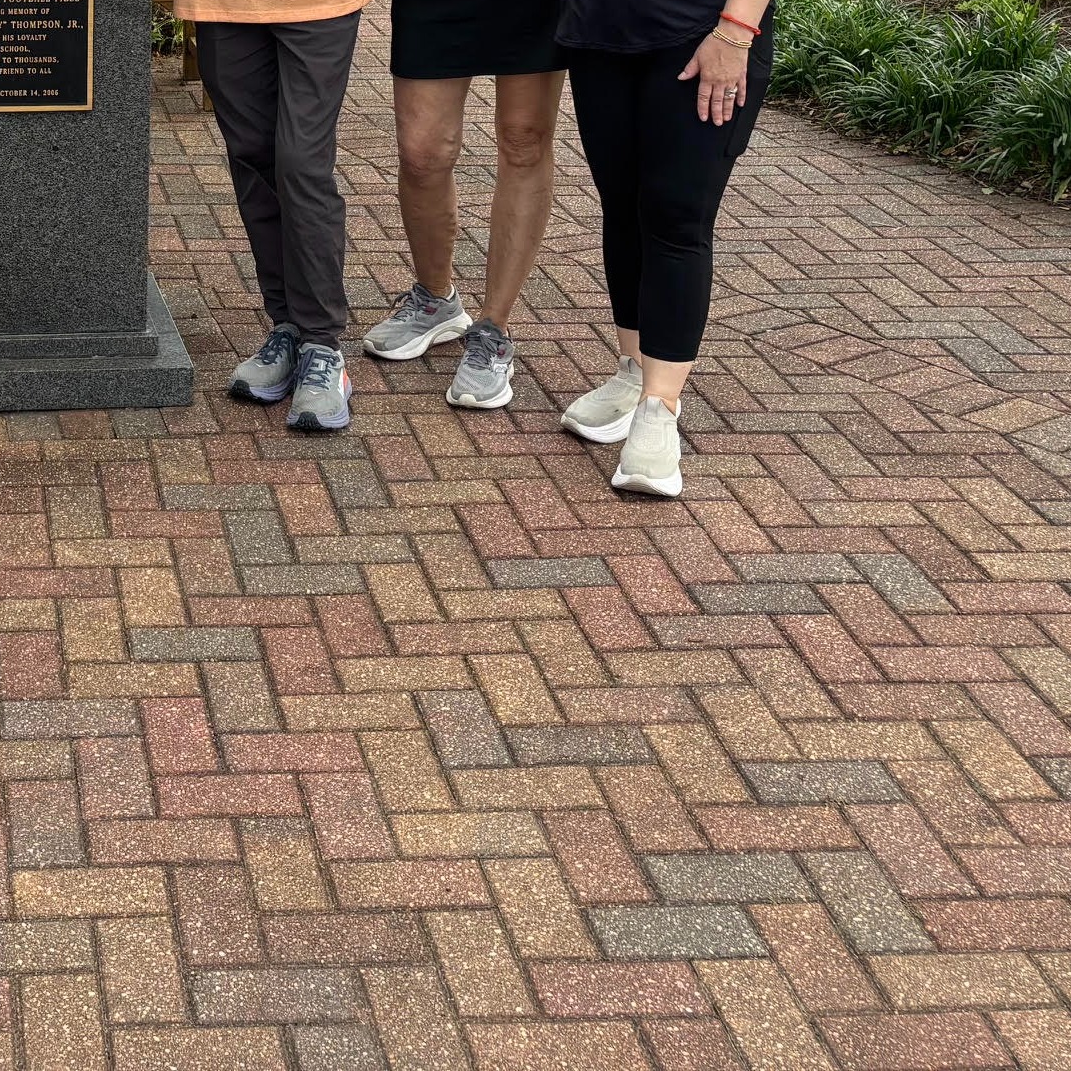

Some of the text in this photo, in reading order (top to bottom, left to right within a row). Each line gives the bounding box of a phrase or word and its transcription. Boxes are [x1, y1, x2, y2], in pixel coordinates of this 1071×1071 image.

[7, 7, 38, 15] MEMORY
[40, 7, 50, 15] OF
[2, 34, 15, 42] HIS
[17, 33, 47, 41] LOYALTY
[1, 56, 12, 64] TO
[26, 67, 37, 75] TO
[39, 67, 52, 75] ALL
